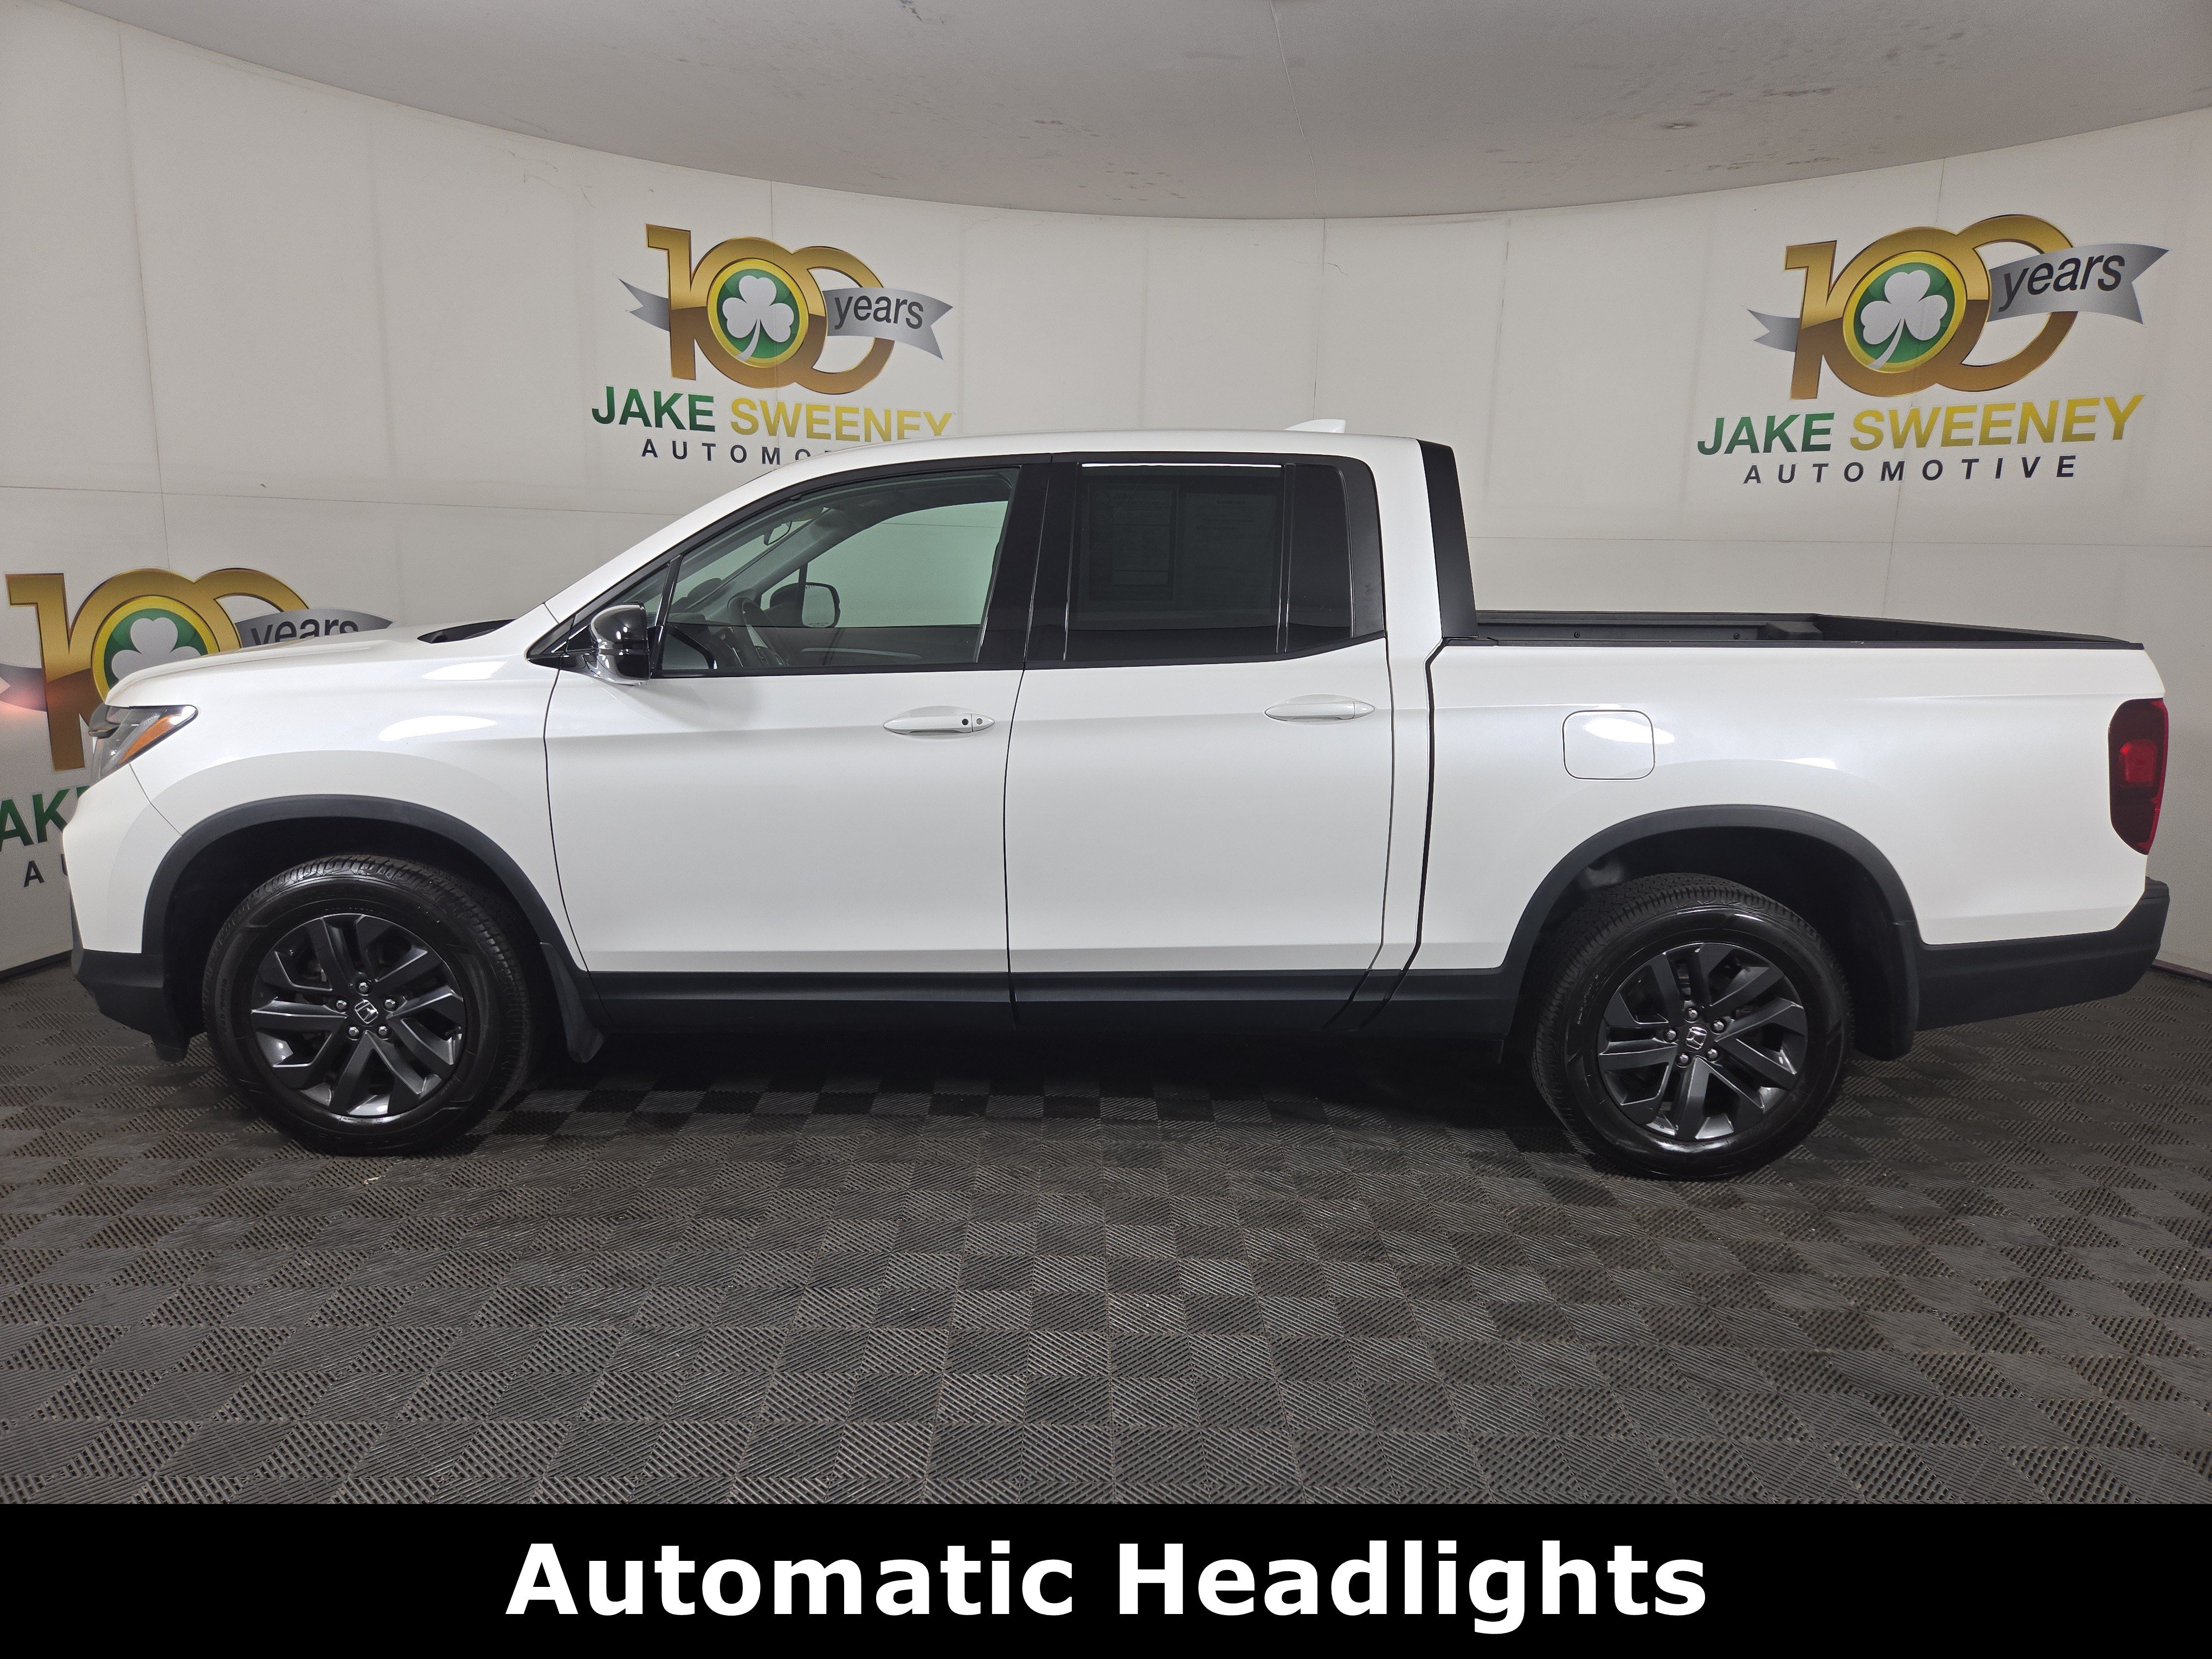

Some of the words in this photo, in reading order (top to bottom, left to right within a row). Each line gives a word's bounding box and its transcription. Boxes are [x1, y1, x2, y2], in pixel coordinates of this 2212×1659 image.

[645, 223, 895, 395] 100
[834, 294, 924, 330] years
[1783, 214, 2078, 400] 100
[1998, 253, 2126, 313] years
[591, 385, 716, 433] JAKE
[730, 397, 953, 443] SWEENEY
[1697, 412, 1835, 455] JAKE
[1849, 394, 2145, 451] SWEENEY
[1742, 455, 2077, 485] AUTOMOTIVE
